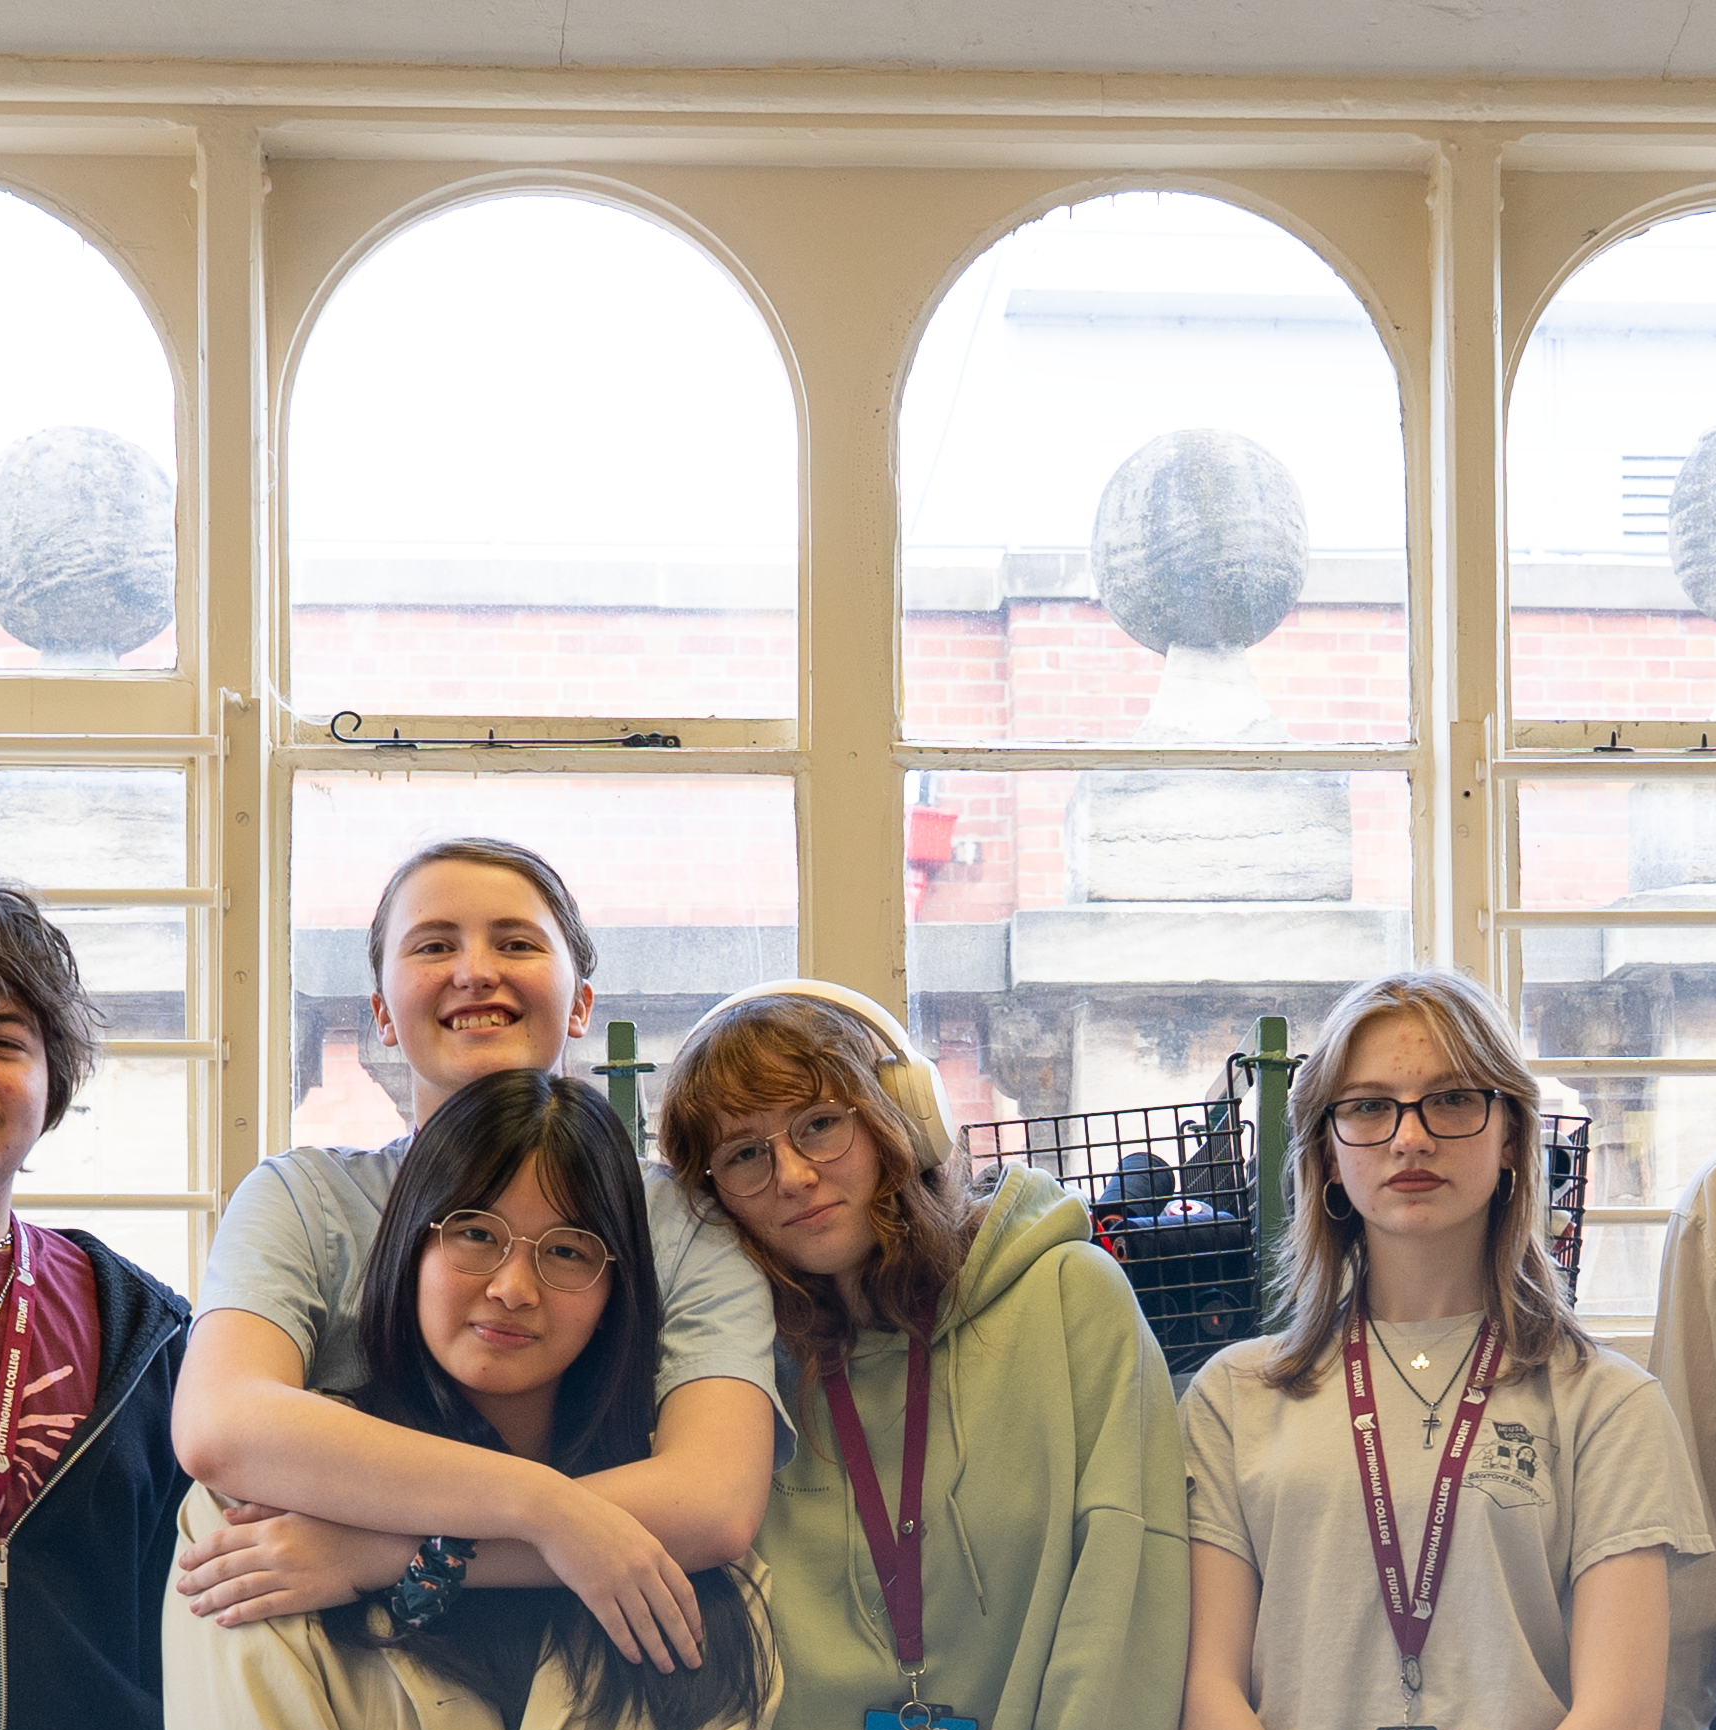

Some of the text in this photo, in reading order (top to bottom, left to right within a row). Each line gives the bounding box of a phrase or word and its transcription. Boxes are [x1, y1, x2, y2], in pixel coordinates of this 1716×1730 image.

[15, 1296, 29, 1334] STUDENT
[5, 1347, 22, 1389] COLLEGE
[1351, 1359, 1366, 1398] STUDENT
[1450, 1418, 1473, 1459] STUDENT
[1362, 1430, 1391, 1546] NOTTINGHAM COLLEGE
[1419, 1476, 1453, 1600] NOTTINGHAM COLLEGE
[1385, 1566, 1404, 1615] STUDENT
